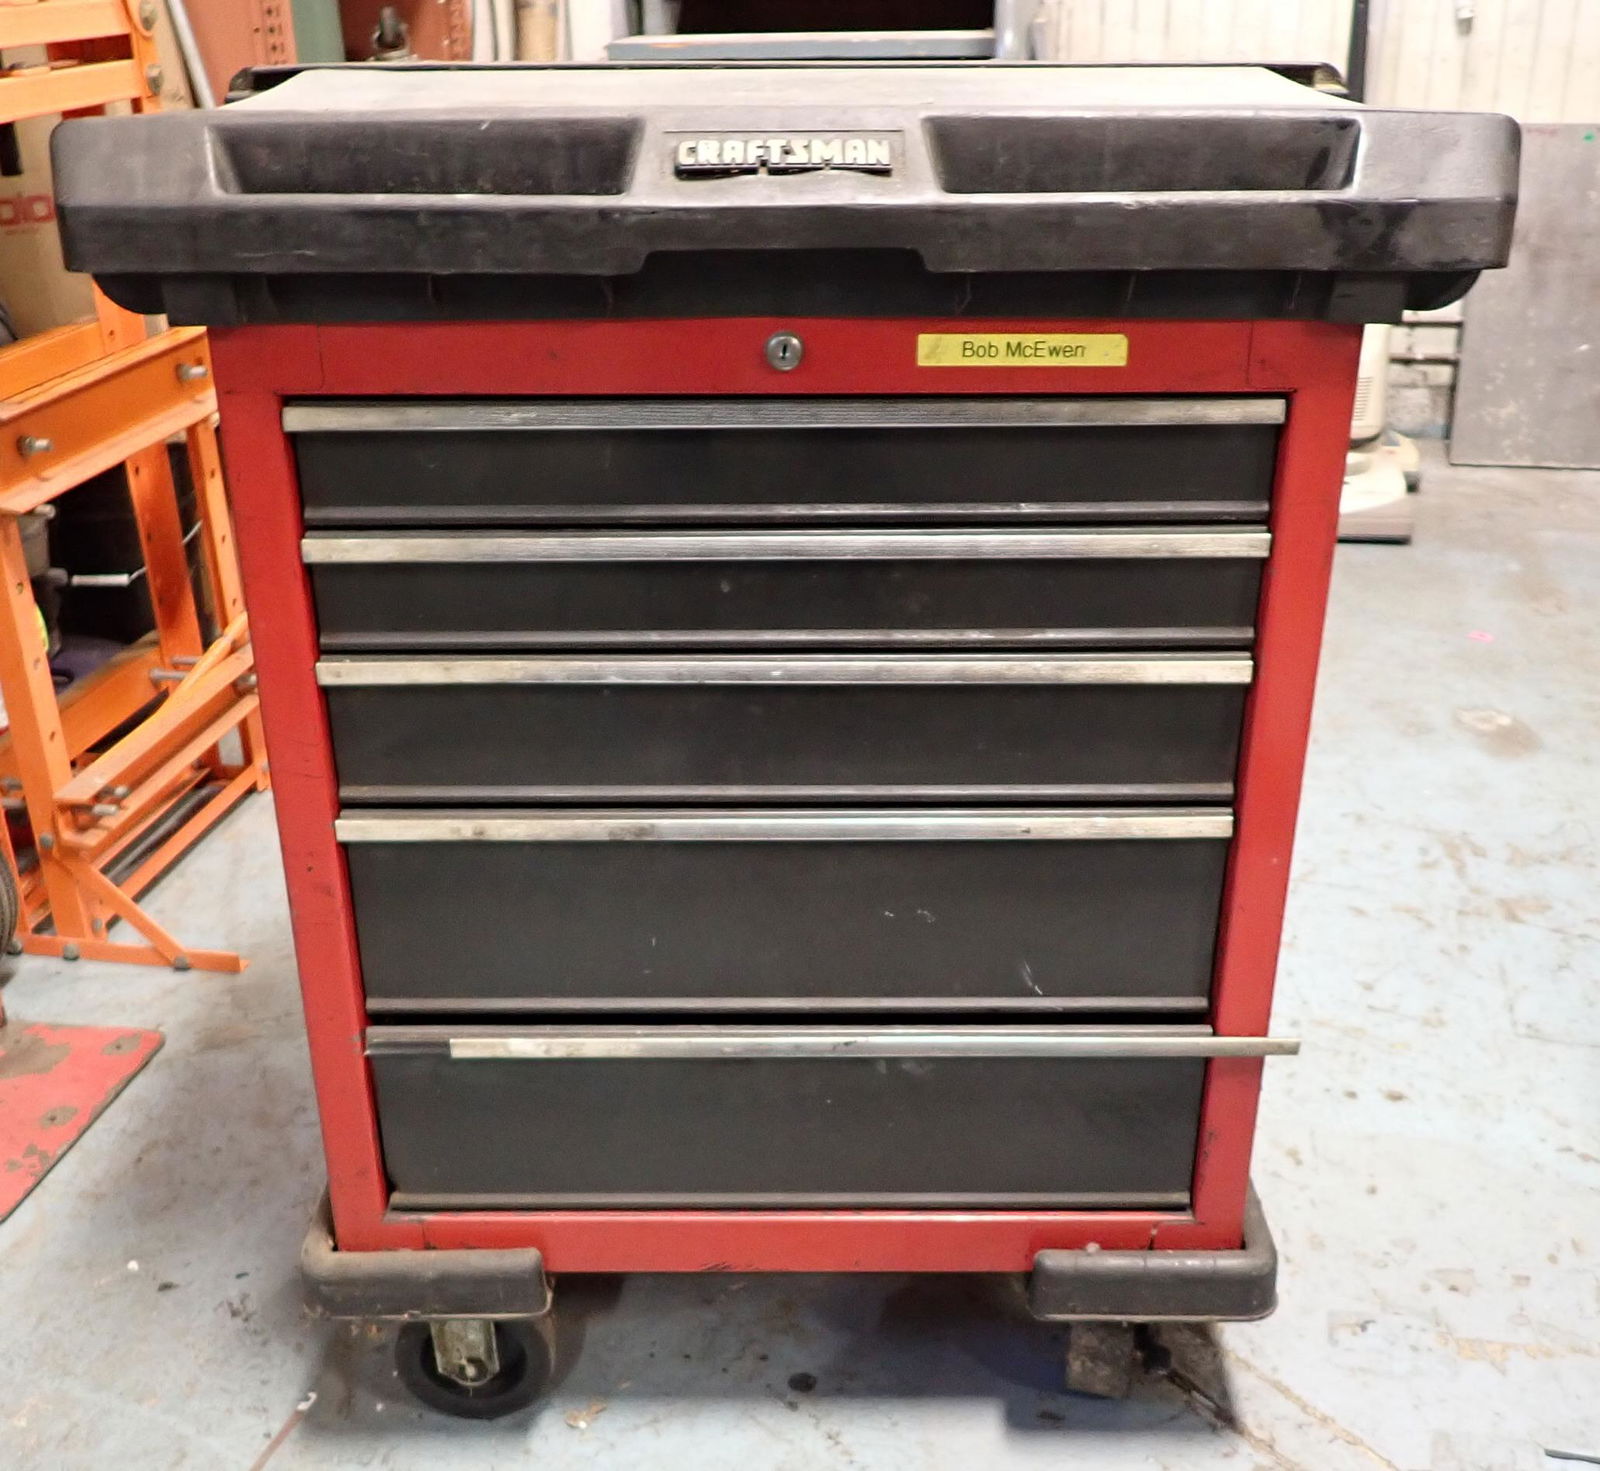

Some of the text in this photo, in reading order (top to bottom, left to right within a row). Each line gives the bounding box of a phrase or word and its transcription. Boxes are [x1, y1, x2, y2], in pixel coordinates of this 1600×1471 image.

[676, 139, 892, 170] CRAFTSMAN
[962, 341, 1086, 358] Bob McEwen
